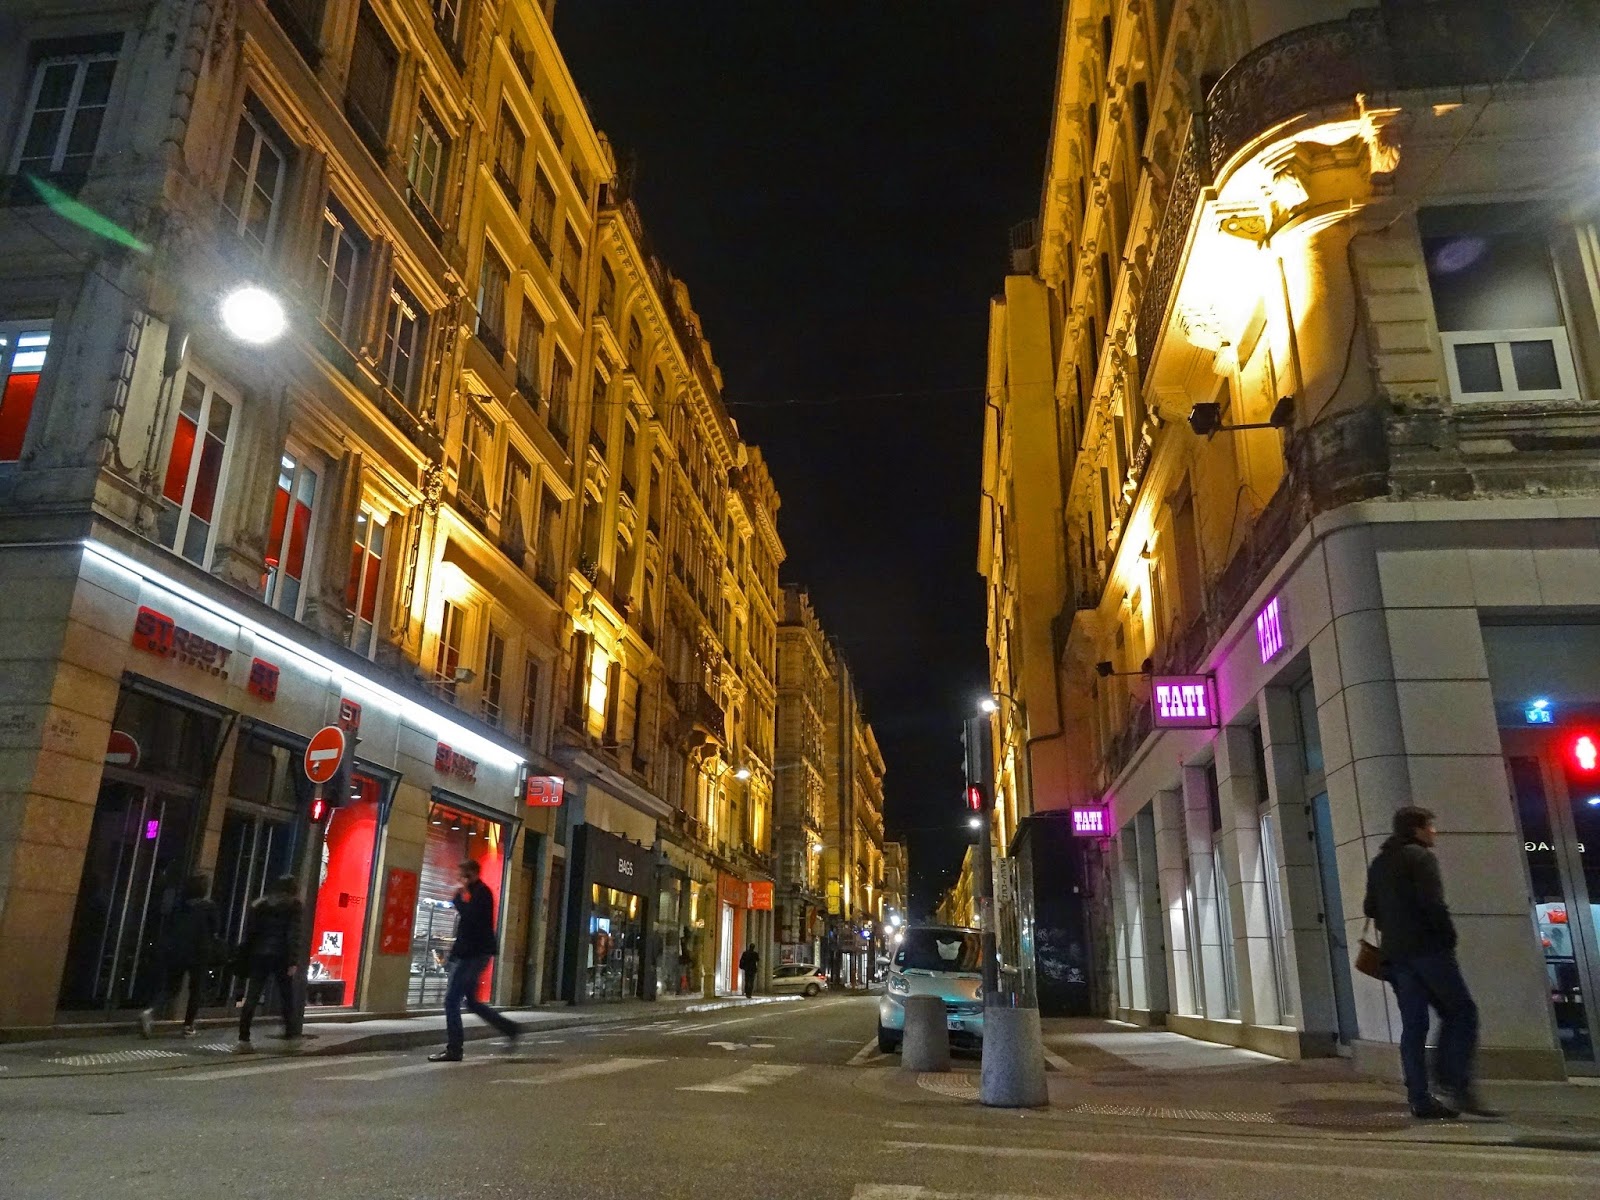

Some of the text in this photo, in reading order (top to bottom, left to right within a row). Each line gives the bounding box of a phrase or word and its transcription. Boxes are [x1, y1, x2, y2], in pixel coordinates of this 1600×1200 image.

[1257, 597, 1282, 664] TATI
[1156, 685, 1207, 717] TATI
[530, 780, 560, 795] ST
[1074, 811, 1103, 831] TATI
[618, 858, 634, 876] BAGS
